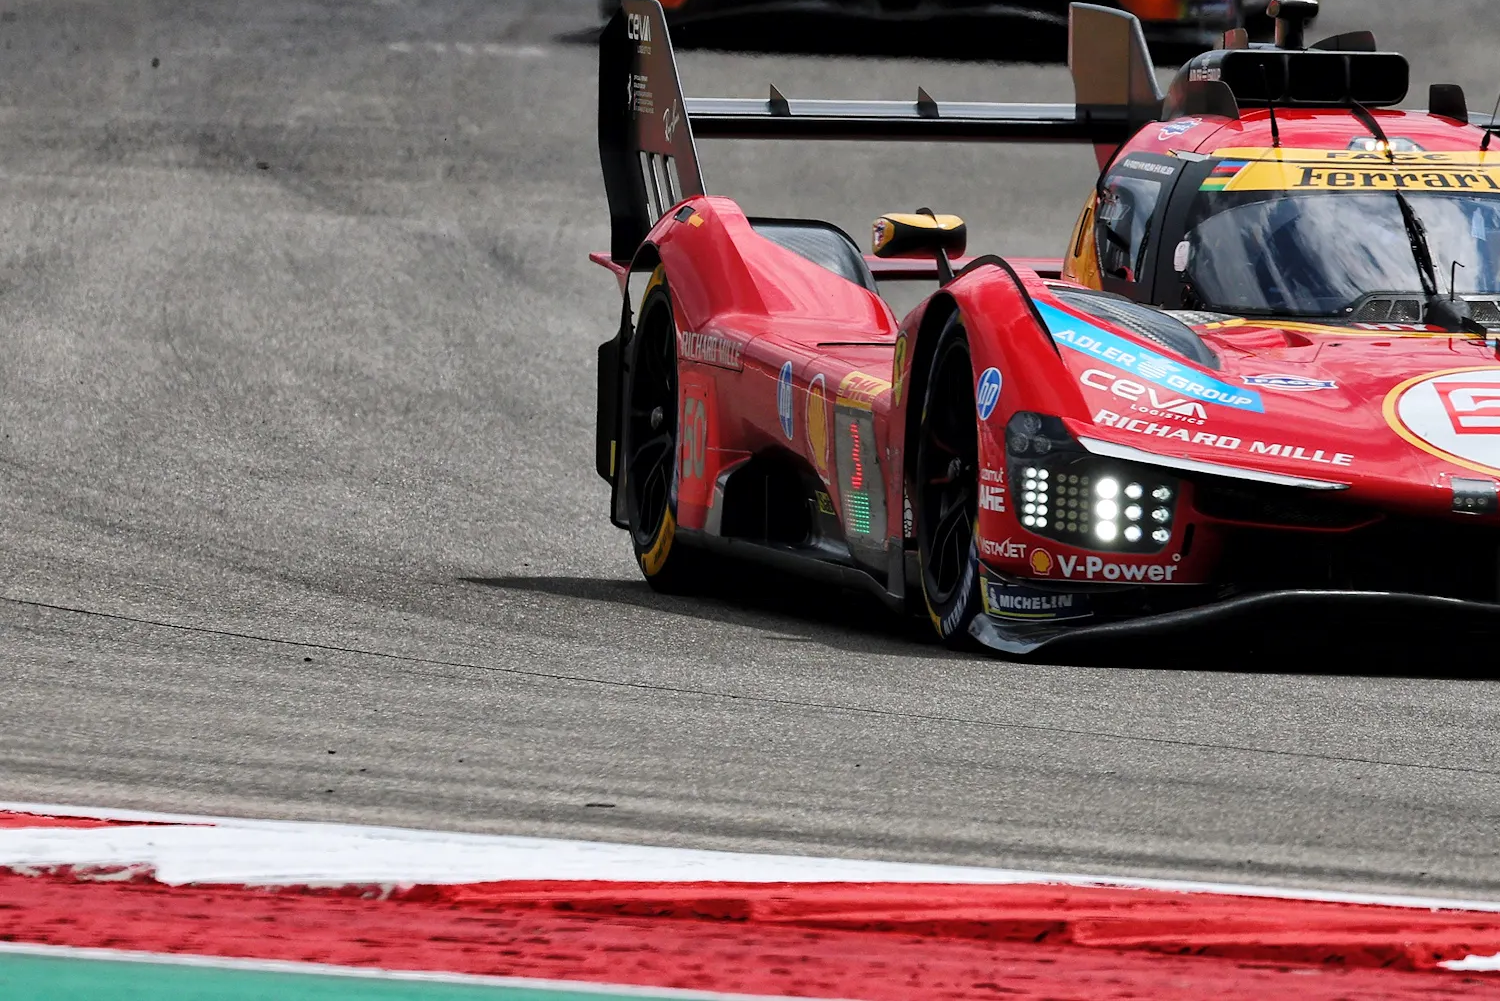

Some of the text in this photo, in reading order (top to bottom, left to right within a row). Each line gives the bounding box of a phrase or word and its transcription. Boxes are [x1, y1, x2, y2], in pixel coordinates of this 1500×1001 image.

[682, 331, 742, 367] RICHARD MILLE
[1053, 329, 1253, 406] ADLER GROUP
[1130, 404, 1205, 425] LOGISTICS
[683, 398, 706, 478] 50
[1093, 409, 1354, 467] RICHARD MILLE
[1057, 555, 1177, 581] V-Power
[1000, 594, 1072, 610] MICHELIN
